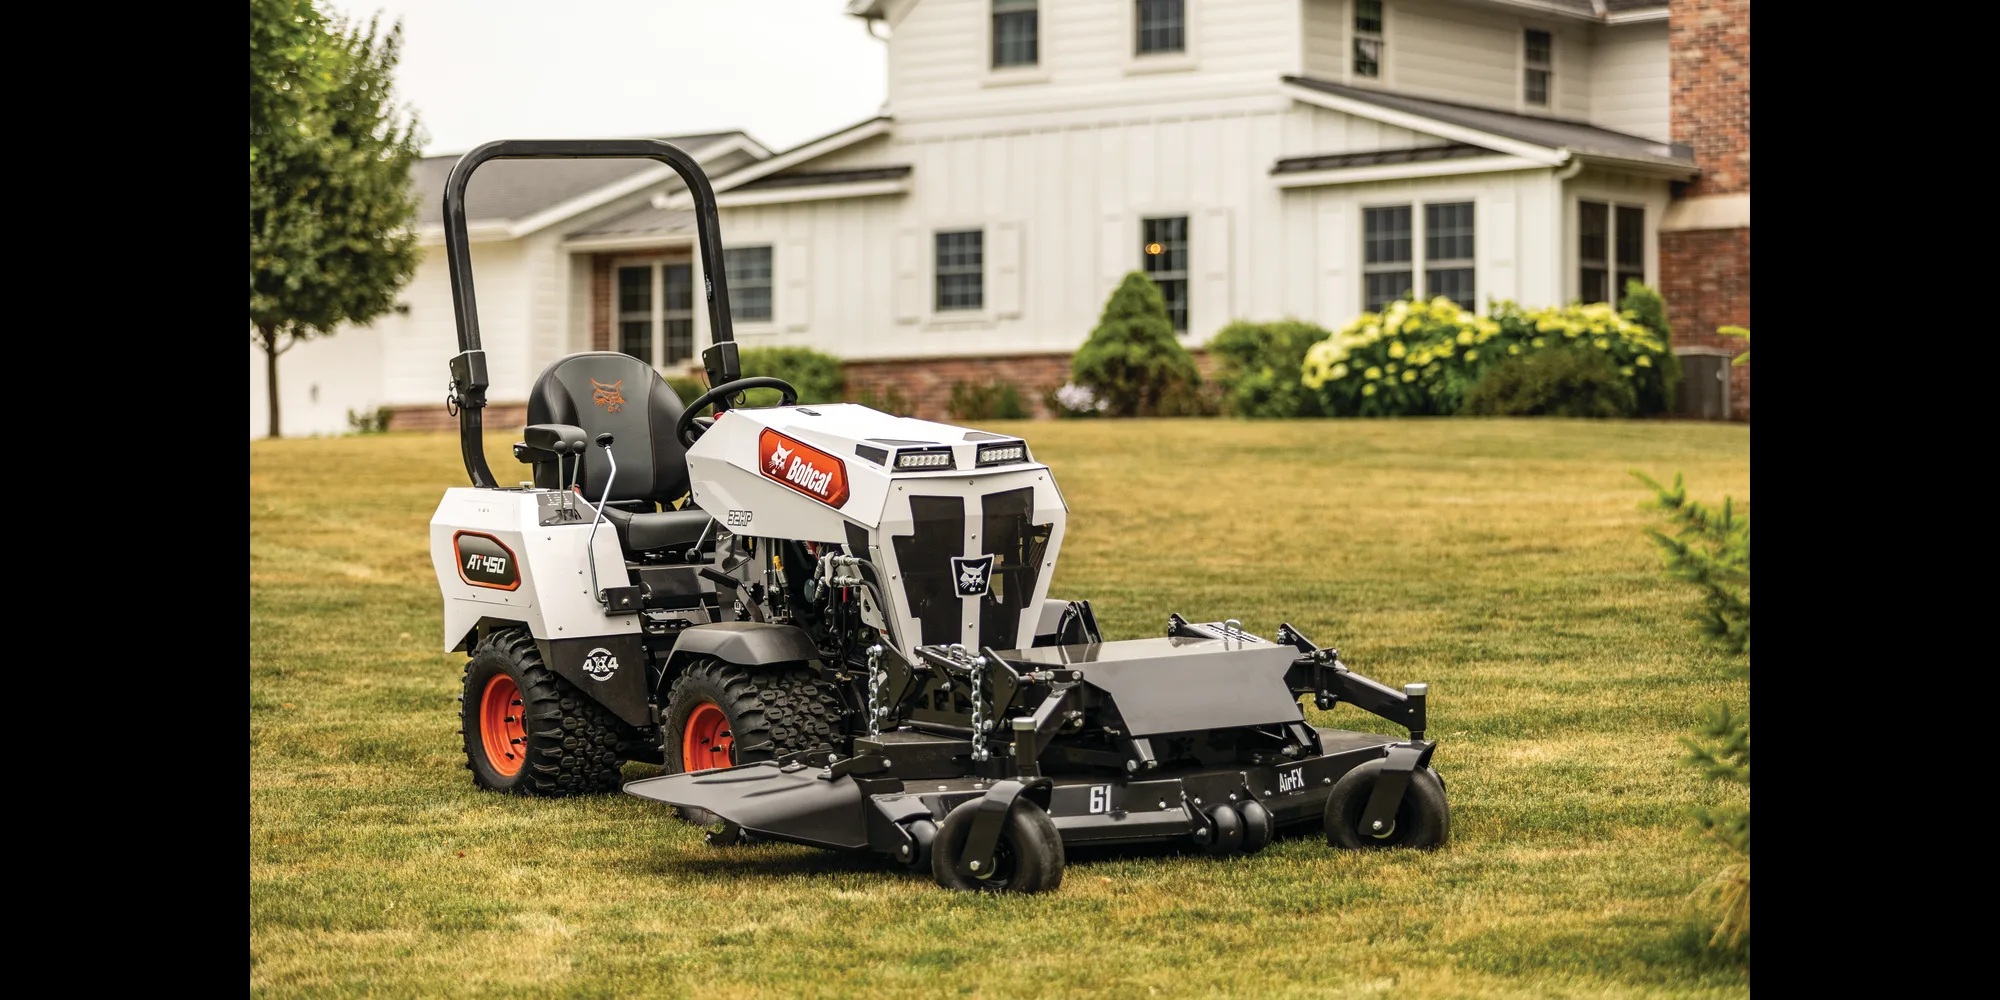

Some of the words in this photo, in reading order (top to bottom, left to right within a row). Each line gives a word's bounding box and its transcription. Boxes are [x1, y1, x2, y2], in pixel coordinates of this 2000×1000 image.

[786, 455, 833, 496] Bobcat
[727, 509, 753, 527] 32HP
[1279, 766, 1305, 793] AirFX
[1090, 785, 1112, 813] 61
